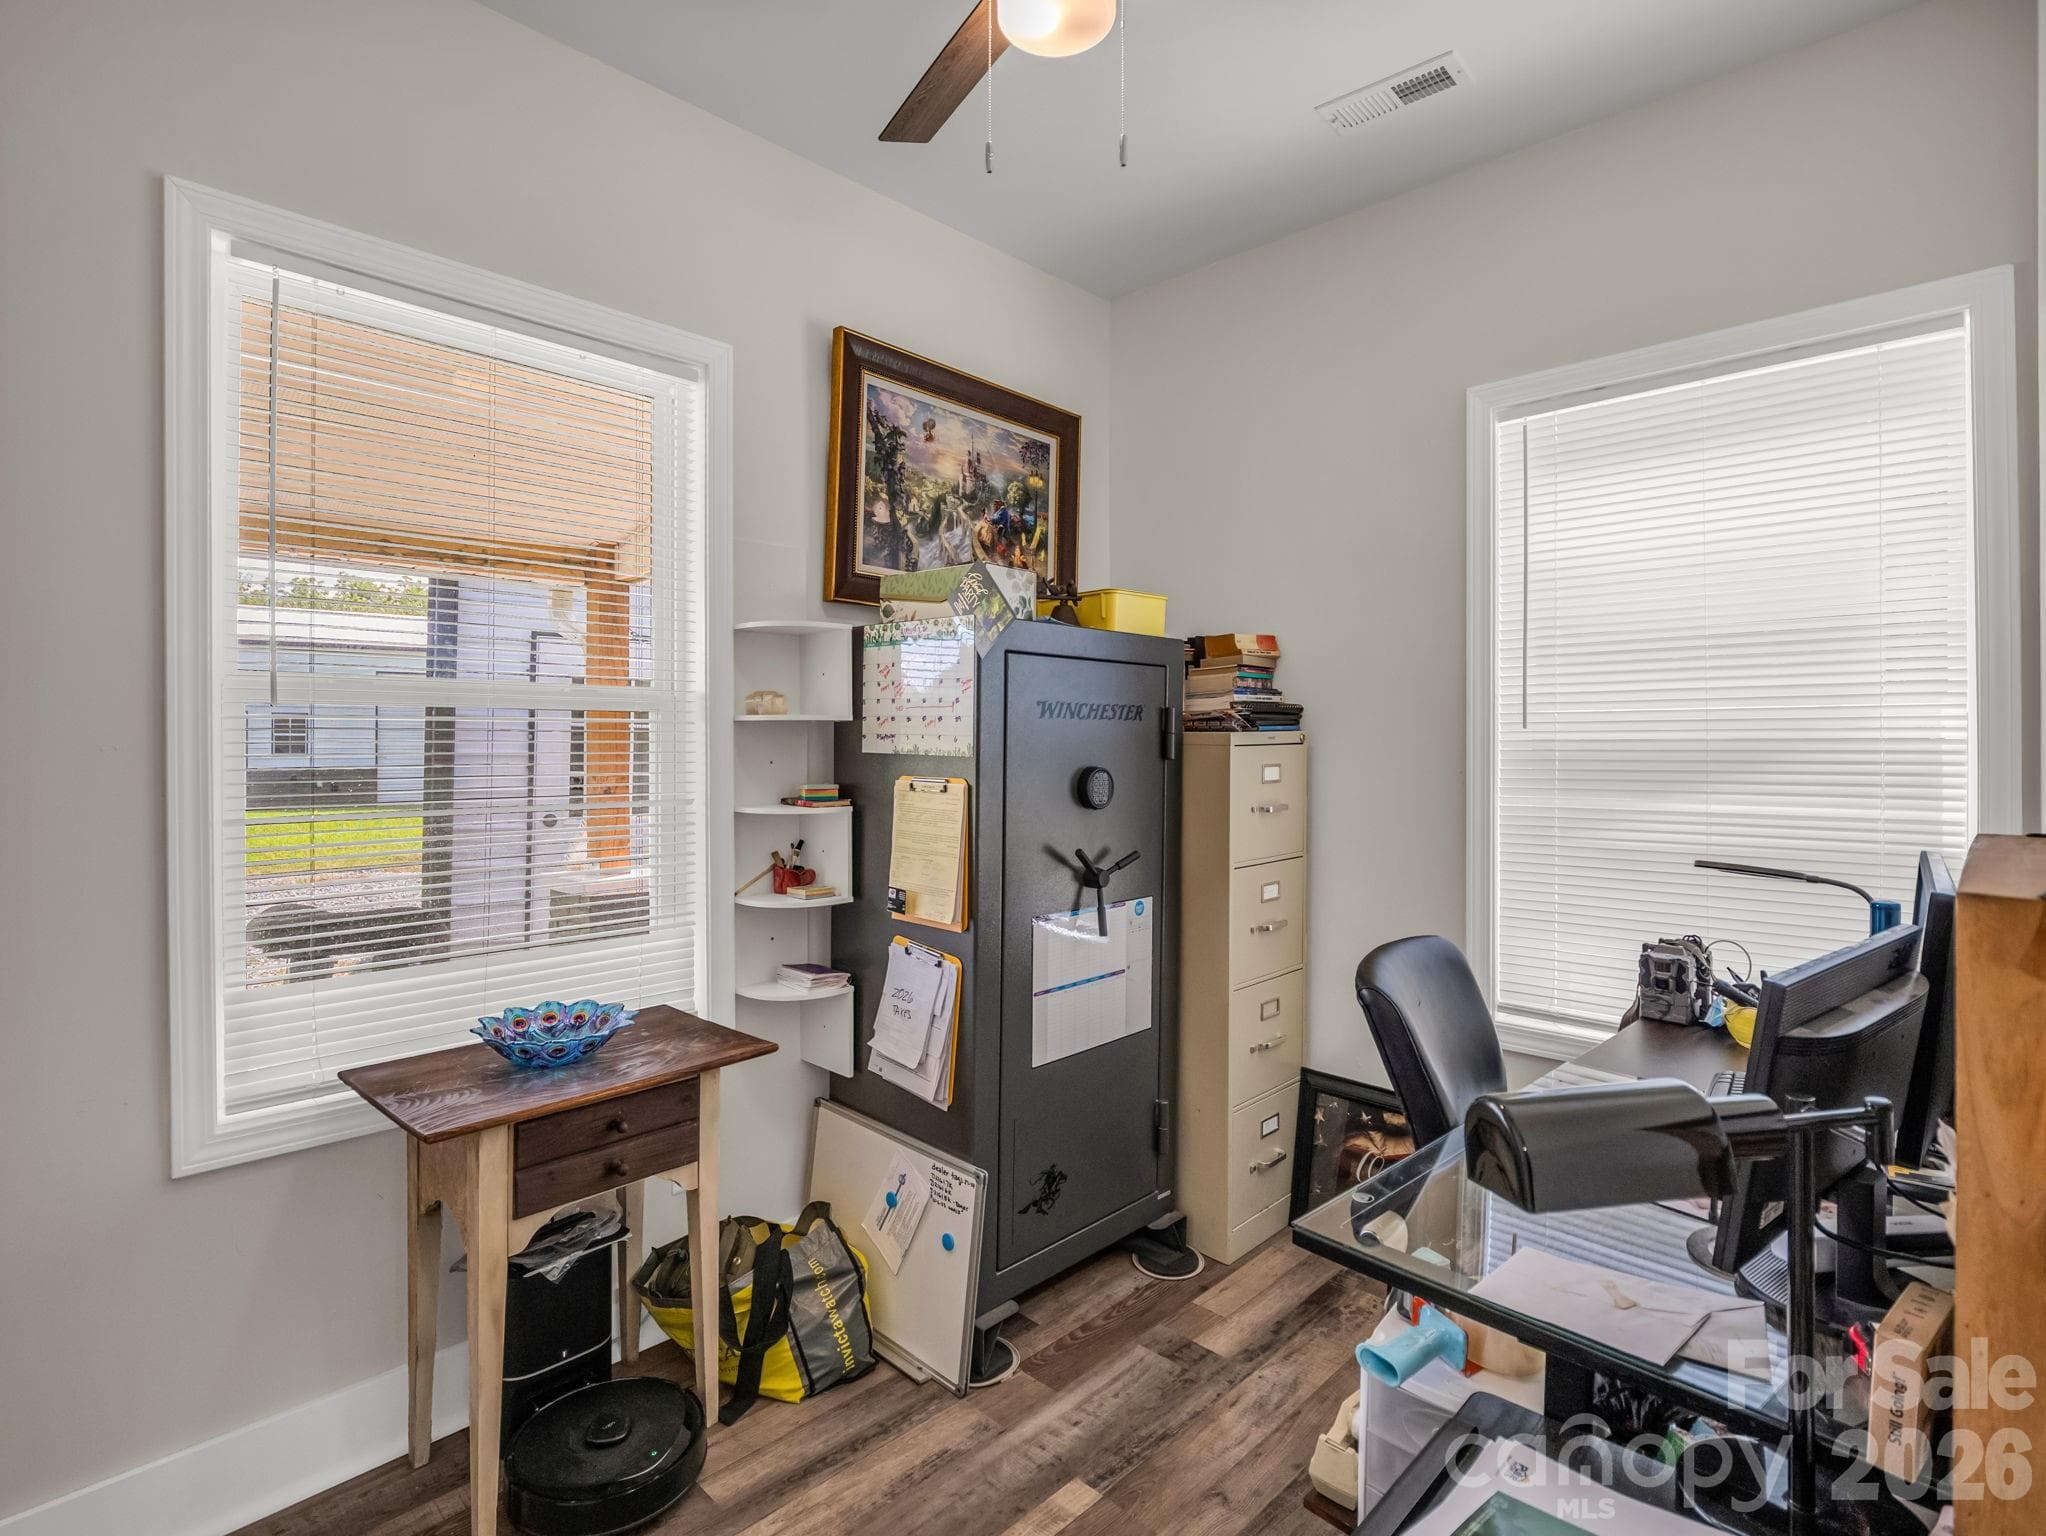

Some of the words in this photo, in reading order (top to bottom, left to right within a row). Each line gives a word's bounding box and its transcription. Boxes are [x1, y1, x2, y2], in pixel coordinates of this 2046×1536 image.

[1036, 700, 1144, 721] WINCHESTER
[891, 987, 913, 1004] 2026
[808, 1257, 856, 1375] invictawatchcom
[1888, 1420, 1903, 1446] Still
